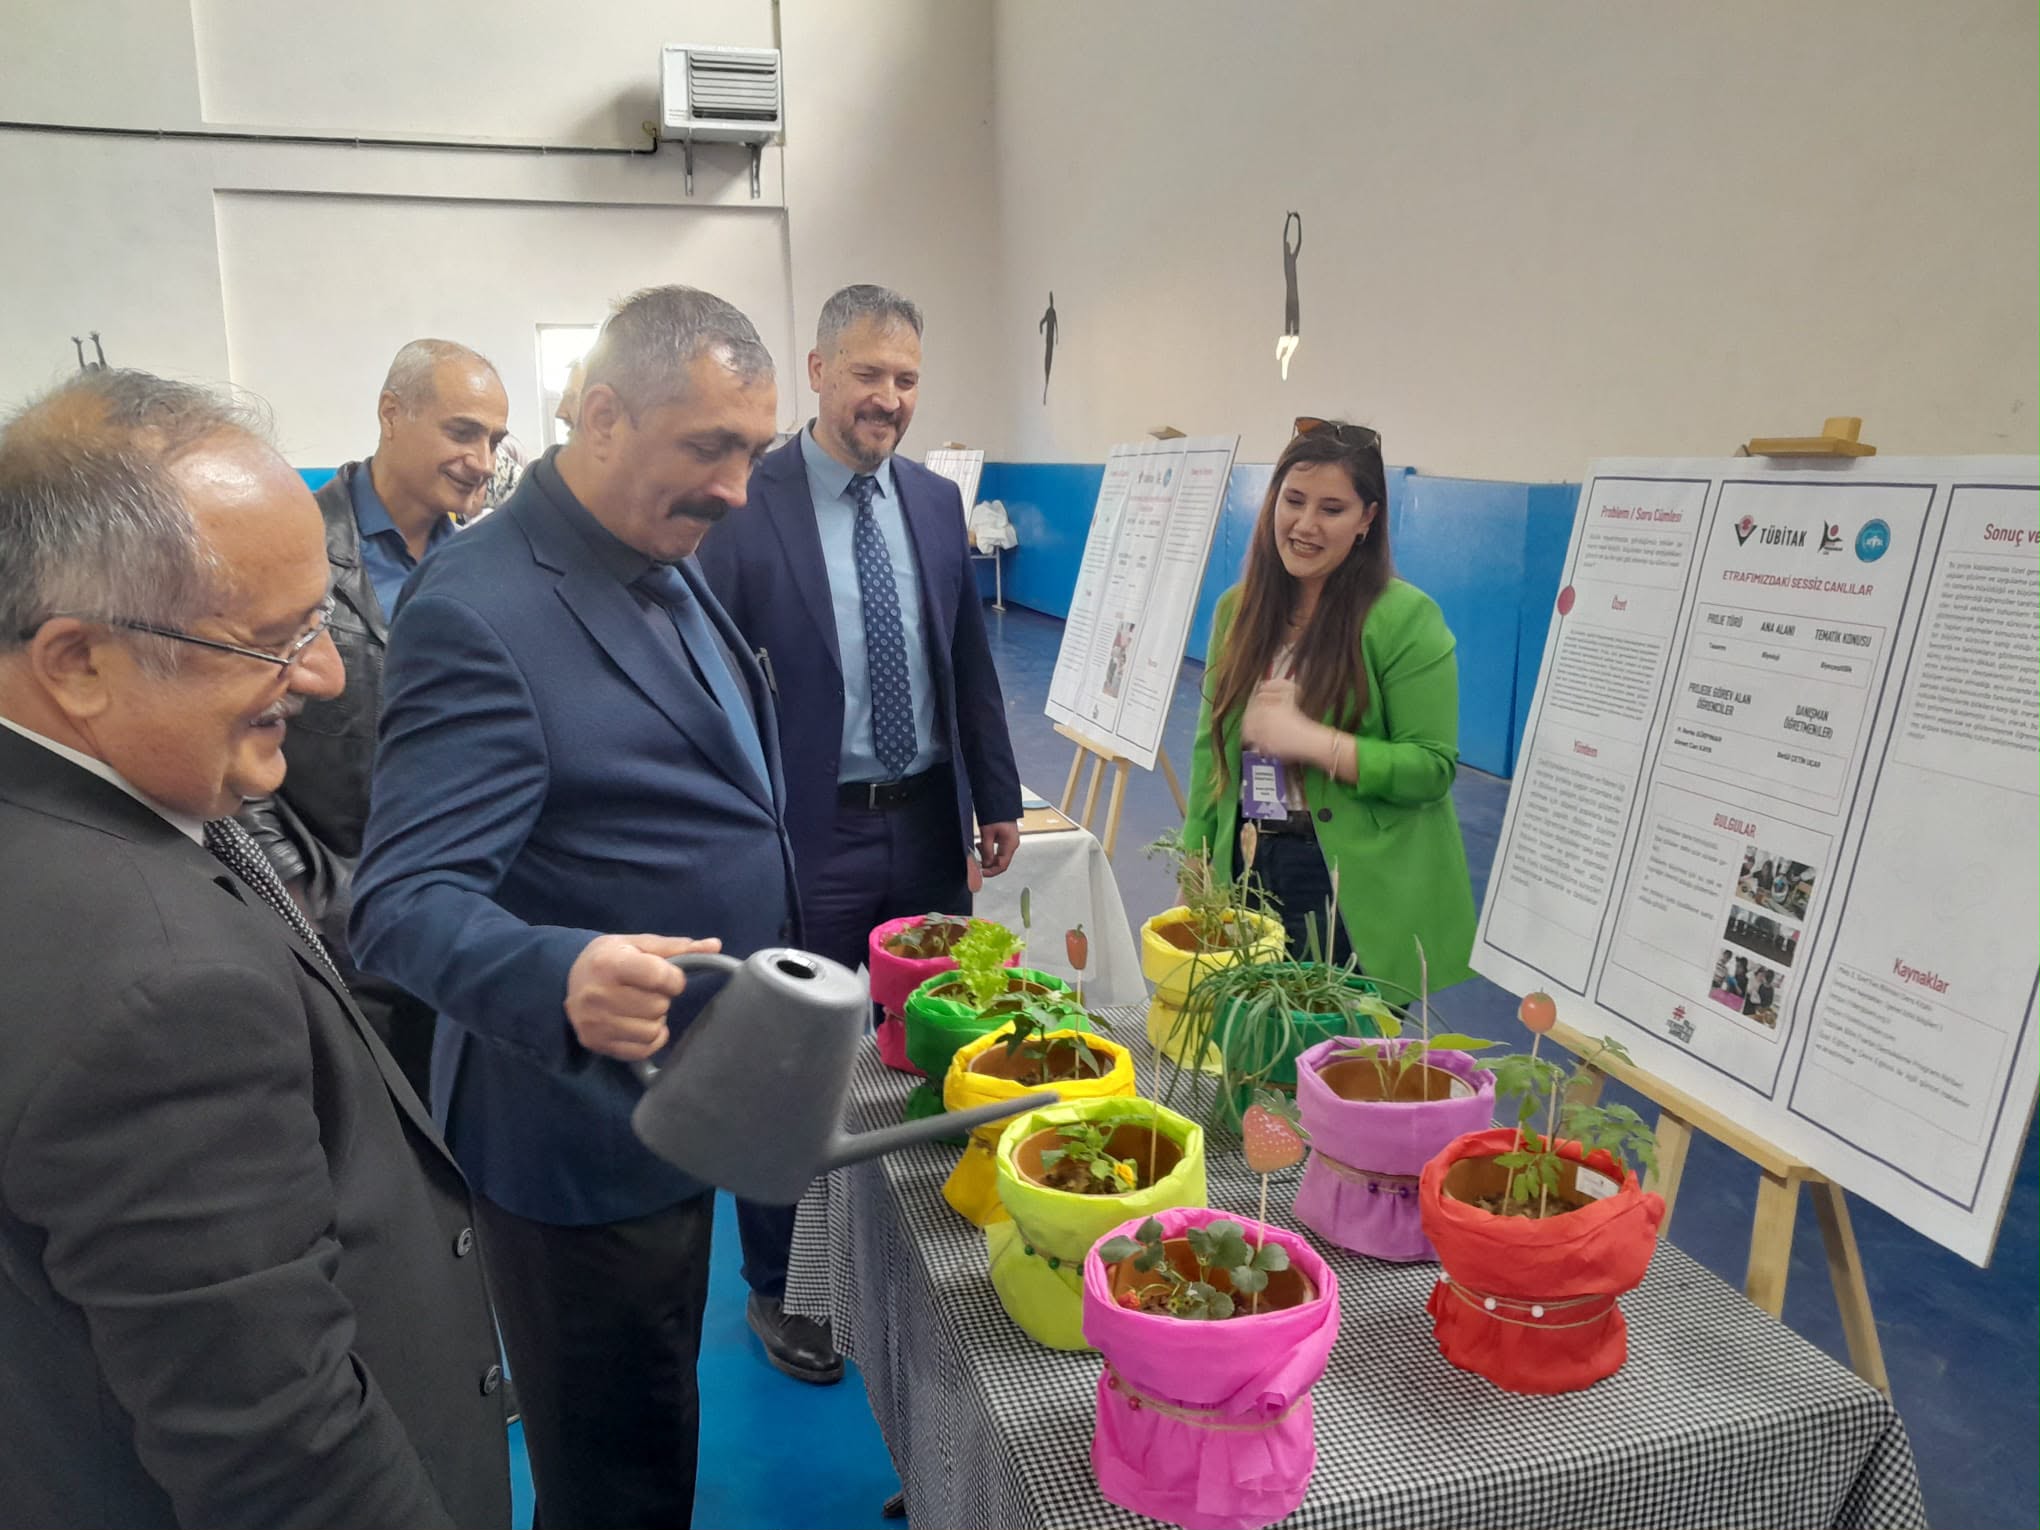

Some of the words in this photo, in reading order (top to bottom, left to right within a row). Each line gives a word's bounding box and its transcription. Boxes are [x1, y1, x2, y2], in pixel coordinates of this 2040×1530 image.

[1760, 525, 1808, 547] TÜBİTAK
[1984, 523, 2024, 547] Sonuç
[2028, 529, 2040, 543] ve
[1722, 570, 1792, 588] ETRAFIMIZDAKİ
[1791, 576, 1823, 591] SESSİZ
[1824, 581, 1874, 596] CANLILAR
[1707, 613, 1725, 626] PROJE
[1726, 614, 1743, 628] TÜRÜ
[1760, 621, 1774, 633] ANA
[1775, 623, 1796, 636] ALANI
[1815, 628, 1842, 644] TEMATİK
[1842, 633, 1872, 648] KONUSU
[1688, 682, 1712, 696] PROJEDE
[1712, 685, 1734, 700] GÖREV
[1734, 693, 1751, 705] ALAN
[1696, 697, 1735, 716] ÖĞRENCİLER
[1796, 705, 1829, 722] DANIŞMAN
[1712, 812, 1757, 838] BULGULAR
[1892, 957, 1950, 994] Kaynaklar
